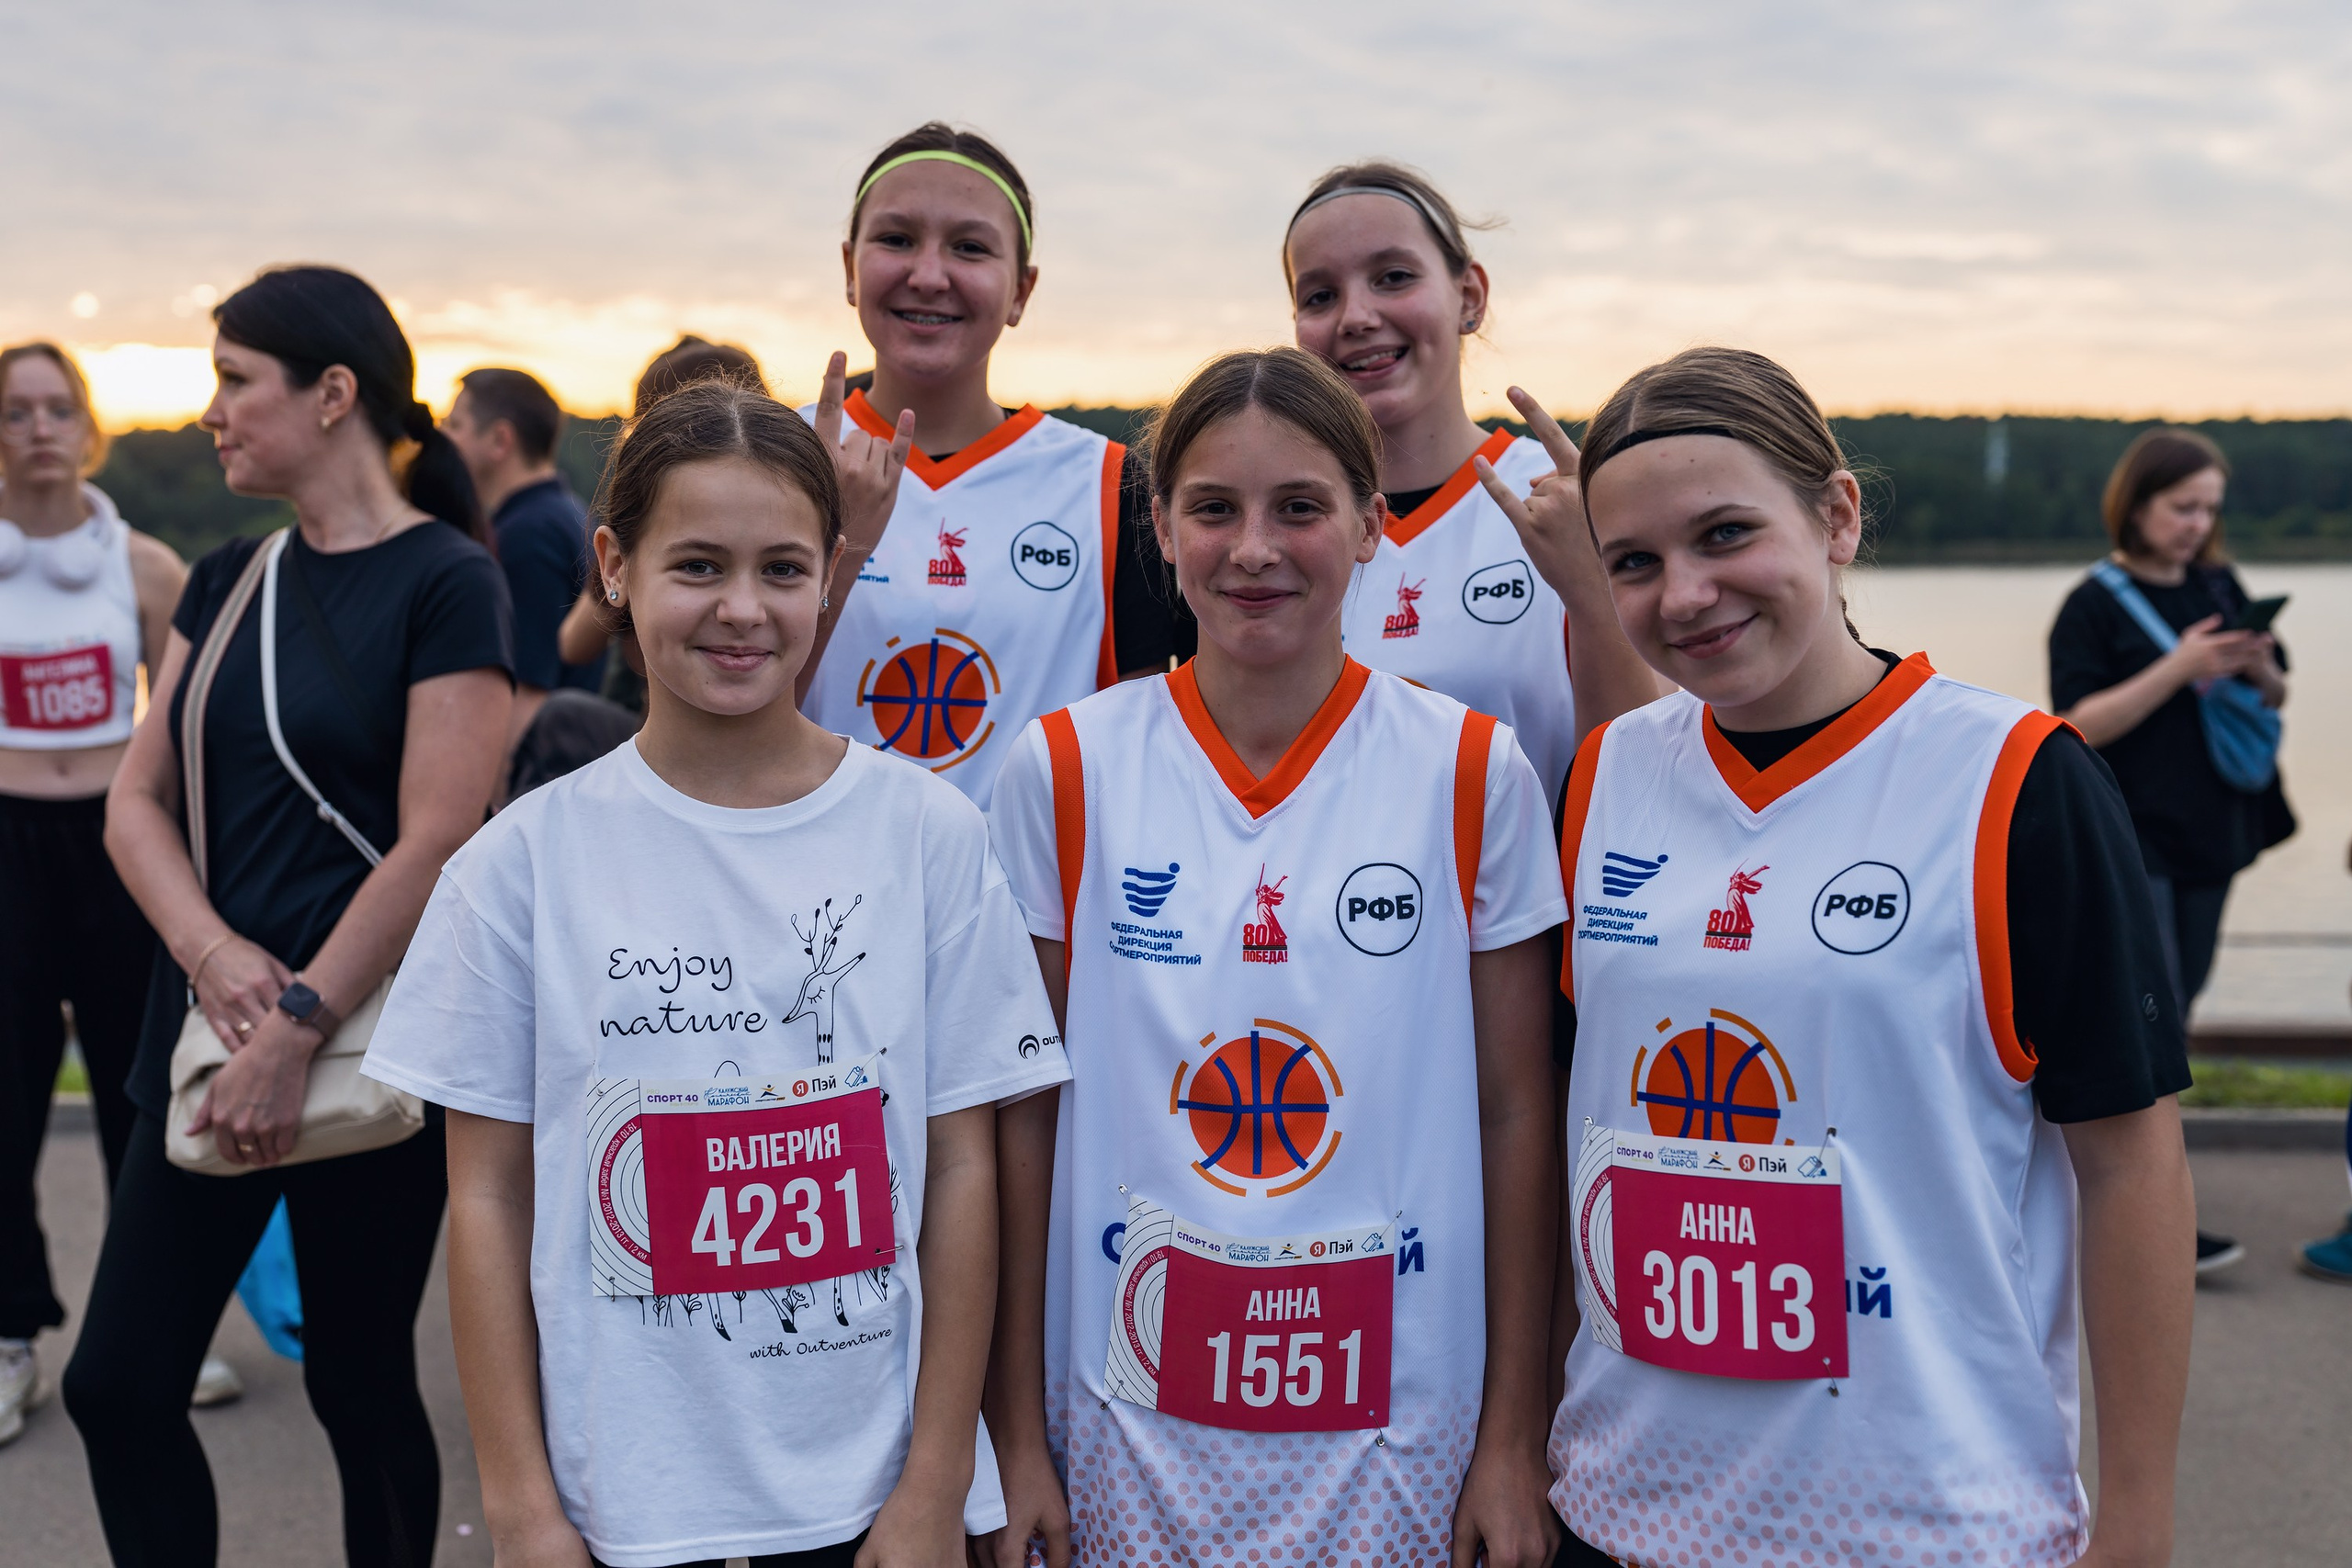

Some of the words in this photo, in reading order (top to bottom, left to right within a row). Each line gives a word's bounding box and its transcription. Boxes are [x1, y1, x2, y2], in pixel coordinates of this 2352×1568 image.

[1021, 544, 1070, 566] РФБ
[929, 559, 948, 574] 80
[1473, 579, 1525, 602] РФБ
[1385, 614, 1406, 629] 80
[1348, 894, 1416, 922] РФБ
[1583, 905, 1647, 920] ФЕДЕРАЛЬНАЯ
[1824, 894, 1897, 919] РФБ
[1111, 921, 1182, 939] ФЕДЕРАЛЬНАЯ
[1587, 918, 1634, 931] ДИРЕКЦИЯ
[1707, 908, 1735, 932] 80
[1118, 935, 1172, 952] ДИРЕКЦИЯ
[1243, 923, 1268, 945] 80
[1703, 936, 1751, 952] ПОБЕДА!
[1243, 950, 1288, 964] ПОБЕДА!
[608, 946, 733, 994] Enjoy
[600, 1000, 768, 1038] nature
[812, 1075, 837, 1092] Пэй
[647, 1094, 683, 1103] СПОРТ
[685, 1094, 698, 1102] 40
[707, 1096, 750, 1106] МАРАФОН
[706, 1122, 841, 1172] ВАЛЕРИЯ
[1617, 1146, 1641, 1158] СПОРТ
[1643, 1150, 1654, 1160] 40
[1660, 1157, 1698, 1169] МАРАФОН
[1758, 1156, 1787, 1173] Пэй
[602, 1201, 625, 1238] 2012-2013
[631, 1246, 639, 1255] 2
[691, 1168, 862, 1267] 4231
[1679, 1201, 1757, 1246] АННА
[1177, 1231, 1207, 1248] СПОРТ
[1208, 1243, 1221, 1252] 40
[1329, 1239, 1353, 1255] Пэй
[1228, 1252, 1269, 1262] МАРАФОН
[1245, 1287, 1321, 1321] АННА
[1643, 1249, 1815, 1352] 3013
[1125, 1313, 1140, 1348] 2012-2013
[750, 1341, 790, 1359] with
[797, 1328, 893, 1355] Outventure
[1207, 1329, 1362, 1407] 1551
